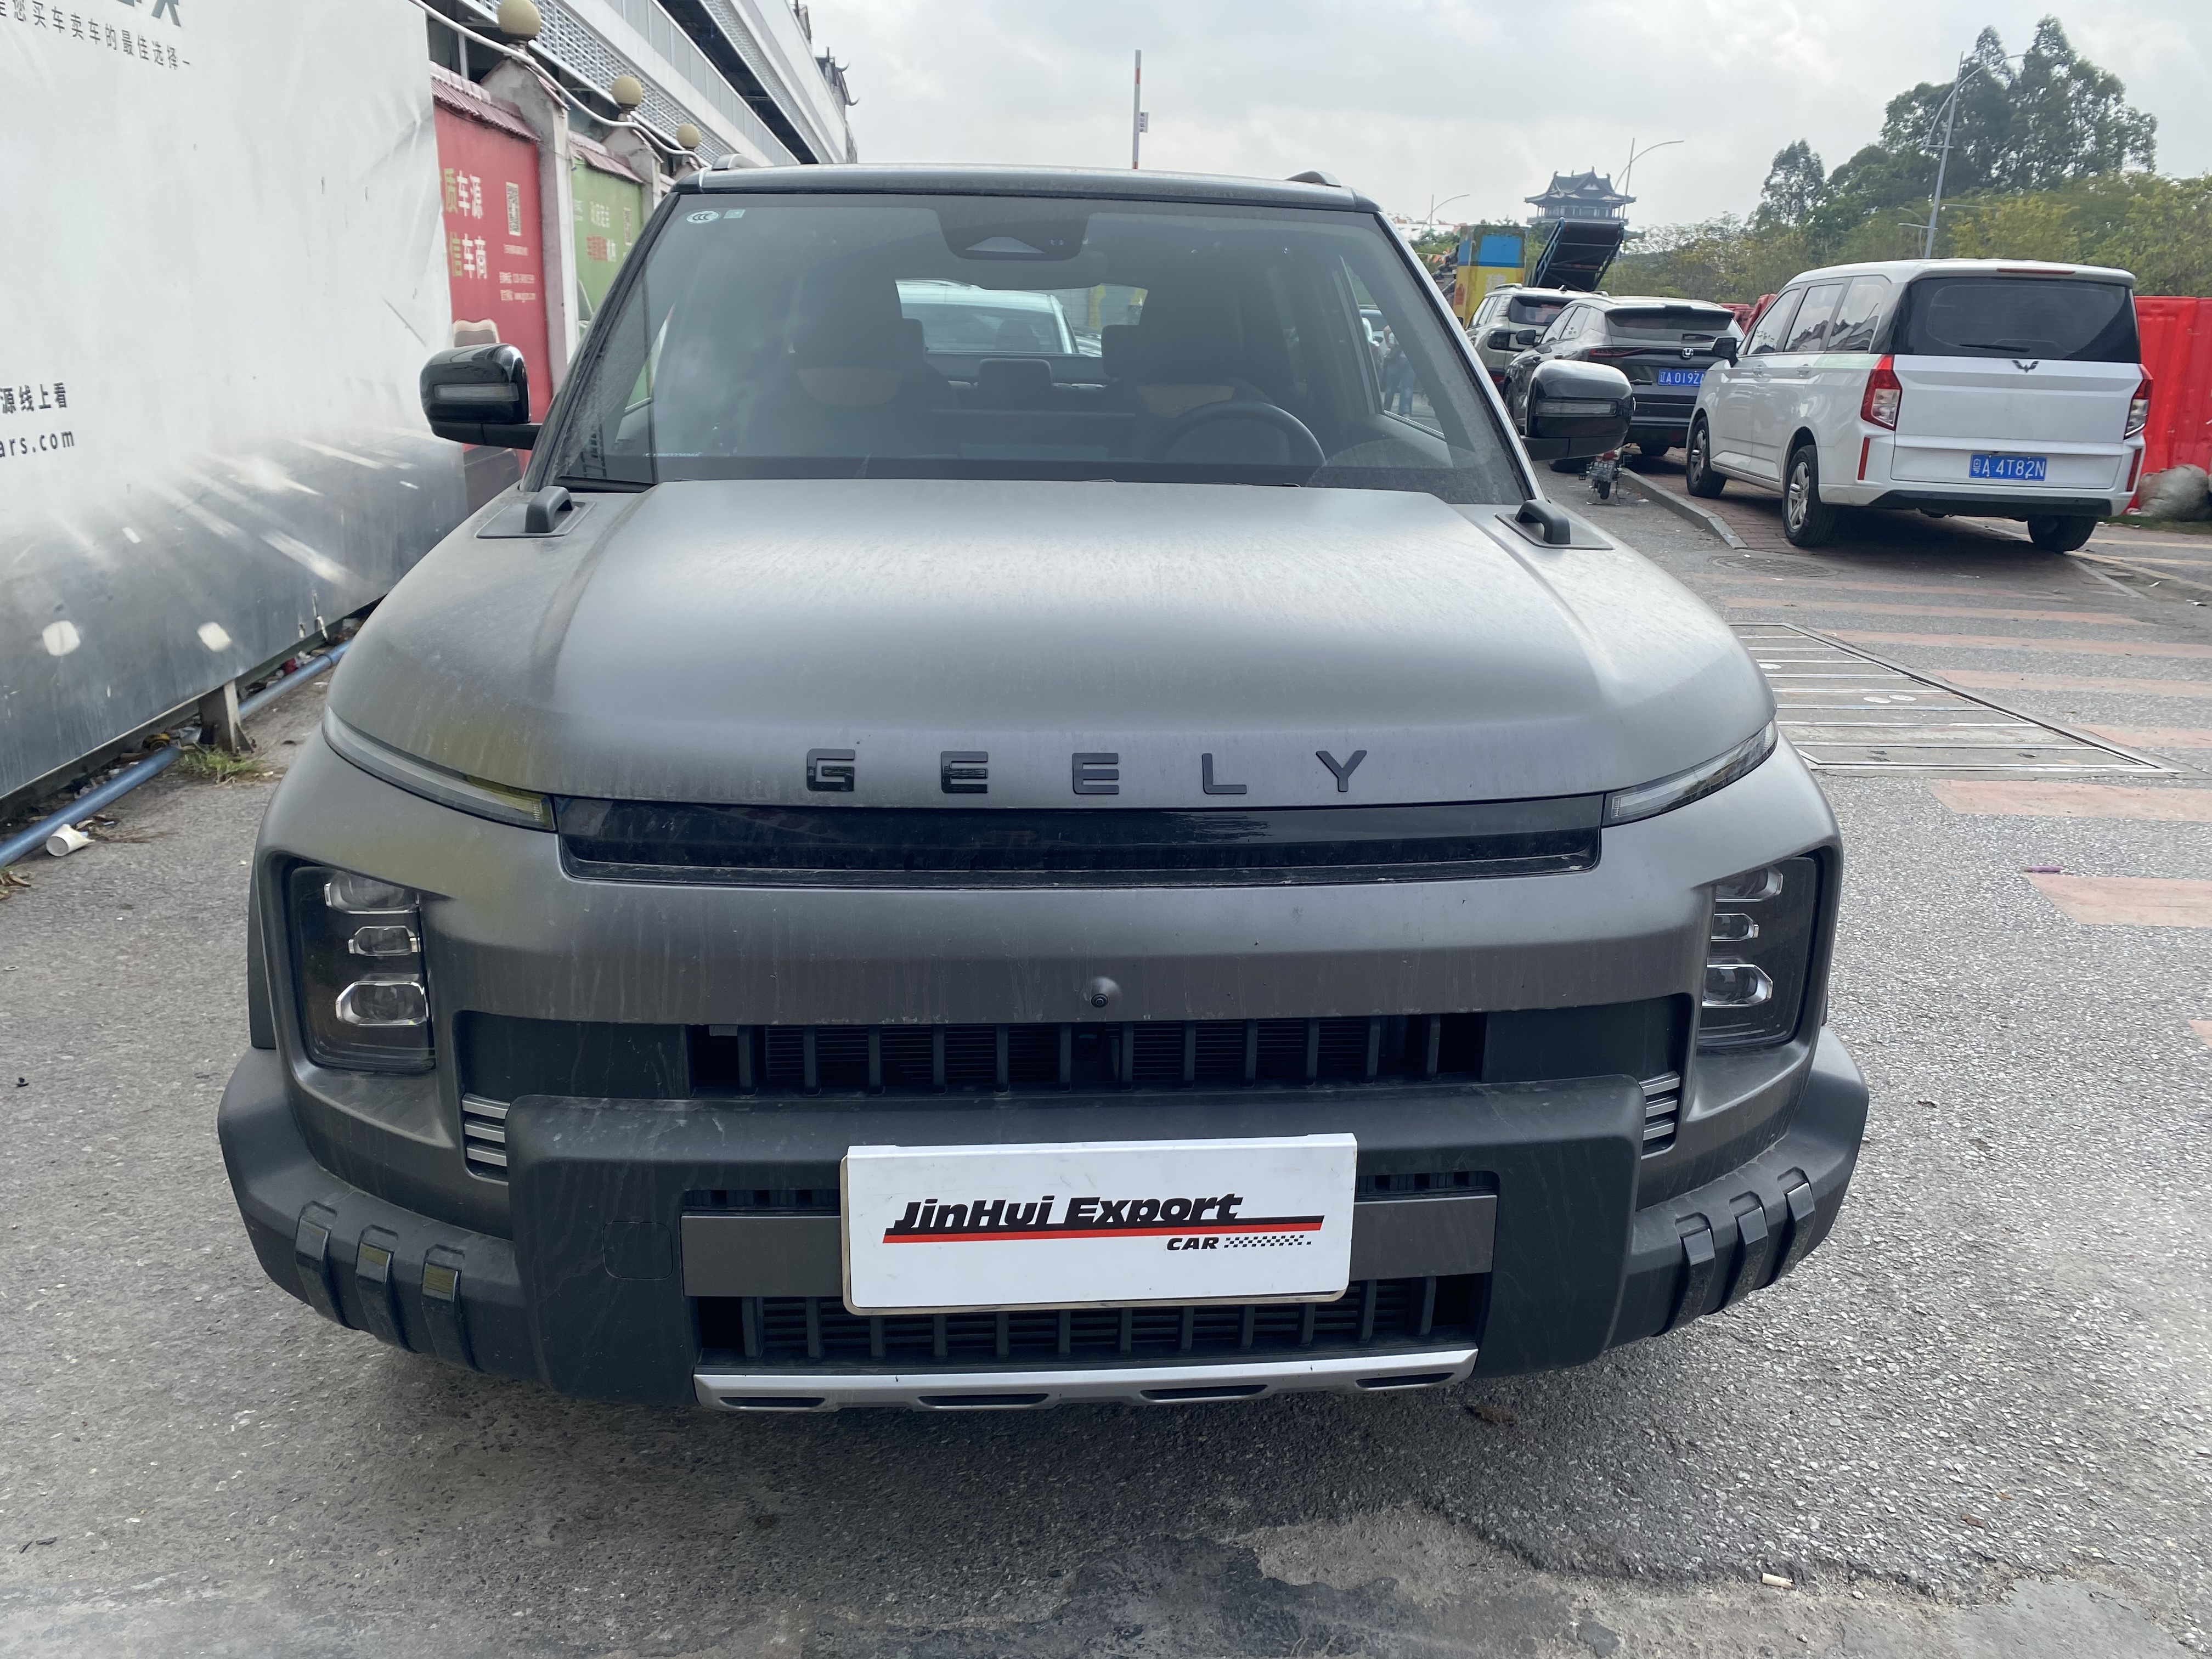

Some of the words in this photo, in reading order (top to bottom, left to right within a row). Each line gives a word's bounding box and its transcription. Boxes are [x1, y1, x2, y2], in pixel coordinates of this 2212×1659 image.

[441, 168, 483, 219] 质车源
[806, 748, 1368, 794] GEELY
[893, 1195, 1055, 1229] JinHui
[1063, 1193, 1243, 1228] Export
[1166, 1236, 1220, 1251] CAR
